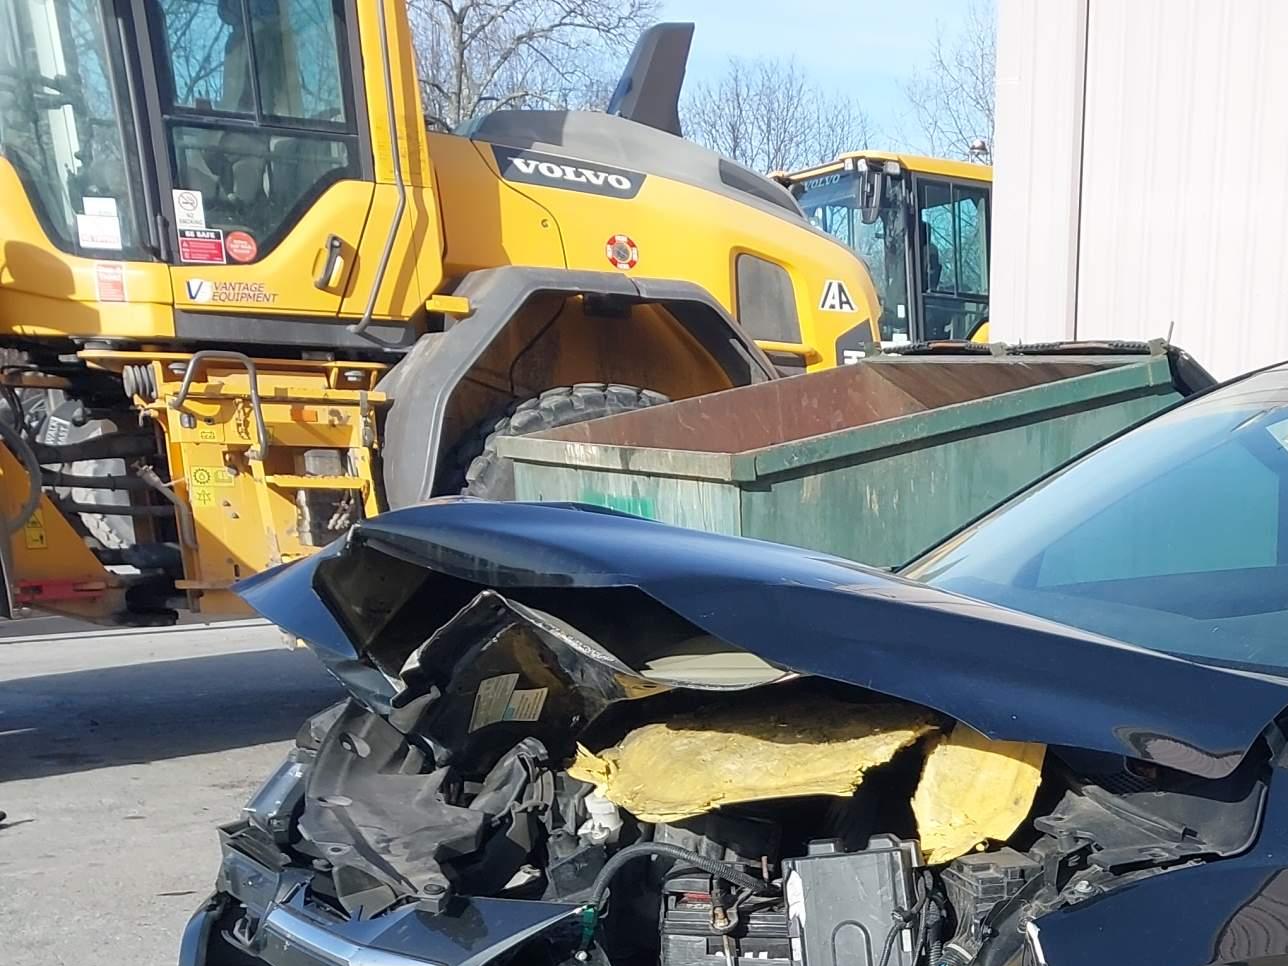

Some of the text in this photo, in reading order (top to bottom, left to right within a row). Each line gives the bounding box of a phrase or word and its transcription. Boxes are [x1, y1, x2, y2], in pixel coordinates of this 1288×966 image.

[507, 156, 632, 190] VOLVO
[804, 173, 841, 192] VOLVO
[213, 281, 265, 293] VANTAGE
[211, 291, 280, 303] EQUIPMENT
